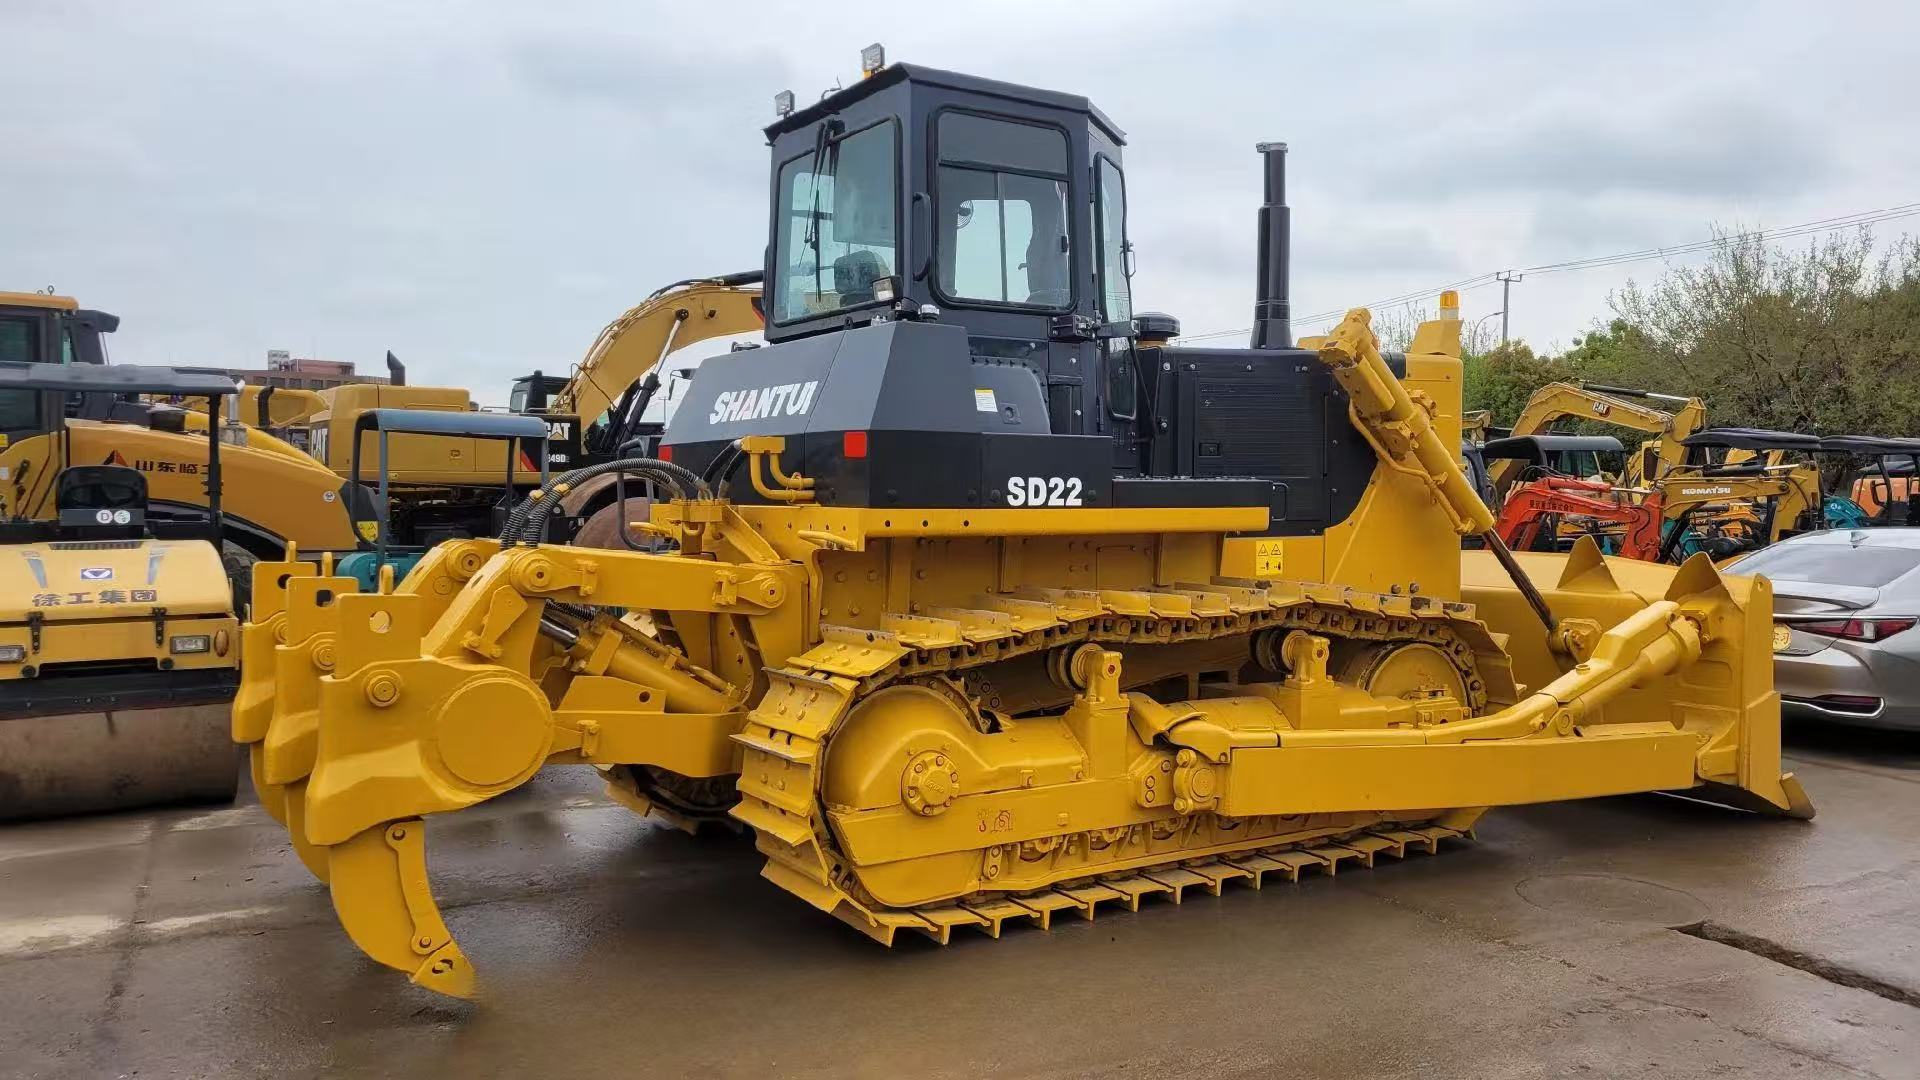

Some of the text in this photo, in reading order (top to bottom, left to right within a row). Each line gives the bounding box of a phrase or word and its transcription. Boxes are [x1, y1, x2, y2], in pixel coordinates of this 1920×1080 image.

[709, 380, 819, 425] SHANTUI
[545, 422, 571, 441] CAT
[1007, 476, 1083, 507] SD22
[1682, 486, 1731, 495] KOMATSU
[32, 589, 157, 607] 徐工集团
